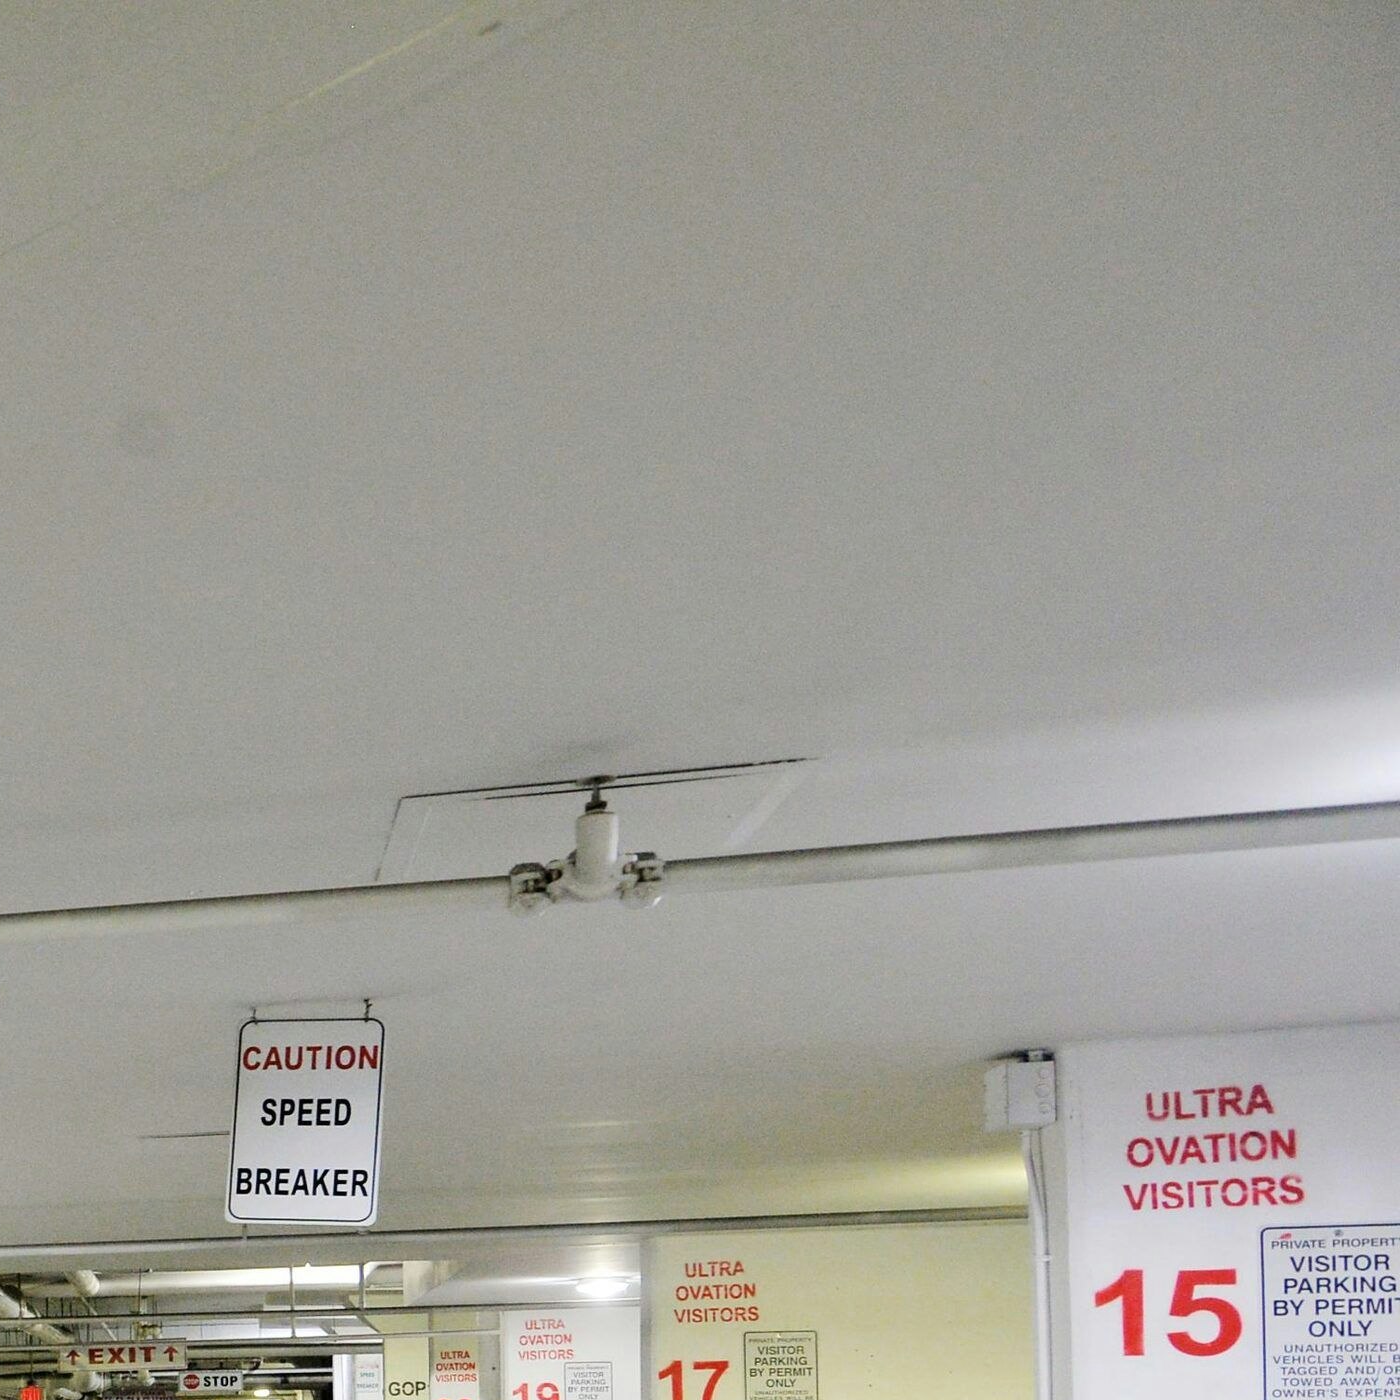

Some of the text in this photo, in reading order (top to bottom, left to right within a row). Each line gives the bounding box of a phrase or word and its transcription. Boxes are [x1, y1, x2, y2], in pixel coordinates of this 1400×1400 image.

[243, 1045, 378, 1070] CAUTION
[1145, 1084, 1274, 1121] ULTRA
[261, 1099, 351, 1126] SPEED
[1126, 1129, 1298, 1168] OVATION
[236, 1168, 368, 1196] BREAKER
[1124, 1175, 1305, 1210] VISITORS
[1271, 1238, 1400, 1249] PRIVATE PROPERT
[1290, 1254, 1389, 1272] VISITOR
[685, 1261, 744, 1278] ULTRA
[1284, 1276, 1397, 1294] PARKING
[675, 1283, 756, 1301] OVATION
[1094, 1268, 1243, 1357] 15
[1273, 1300, 1303, 1316] BY
[674, 1306, 759, 1323] VISITORS
[525, 1318, 565, 1330] ULTRA
[1308, 1320, 1372, 1337] ONLY
[519, 1334, 572, 1346] OVATION
[757, 1346, 805, 1355] VISITOR
[1284, 1343, 1398, 1353] UNAUTHORIZED
[89, 1346, 156, 1364] EXIT
[440, 1351, 470, 1360] ULTRA
[518, 1349, 574, 1360] VISITORS
[1273, 1355, 1344, 1364] VEHICLES
[1350, 1355, 1386, 1364] WILL
[436, 1362, 476, 1372] OVATION
[754, 1357, 807, 1366] PARKING
[749, 1367, 813, 1377] BY PERMIT
[1281, 1366, 1338, 1376] TAGGED
[203, 1376, 238, 1387] STOP
[435, 1373, 478, 1383] VISITORS
[766, 1379, 796, 1388] ONLY
[1281, 1378, 1333, 1387] TOWED
[1340, 1377, 1379, 1386] AWAY
[388, 1381, 429, 1396] GOP
[1272, 1389, 1400, 1398] OWNER'S EXPENS
